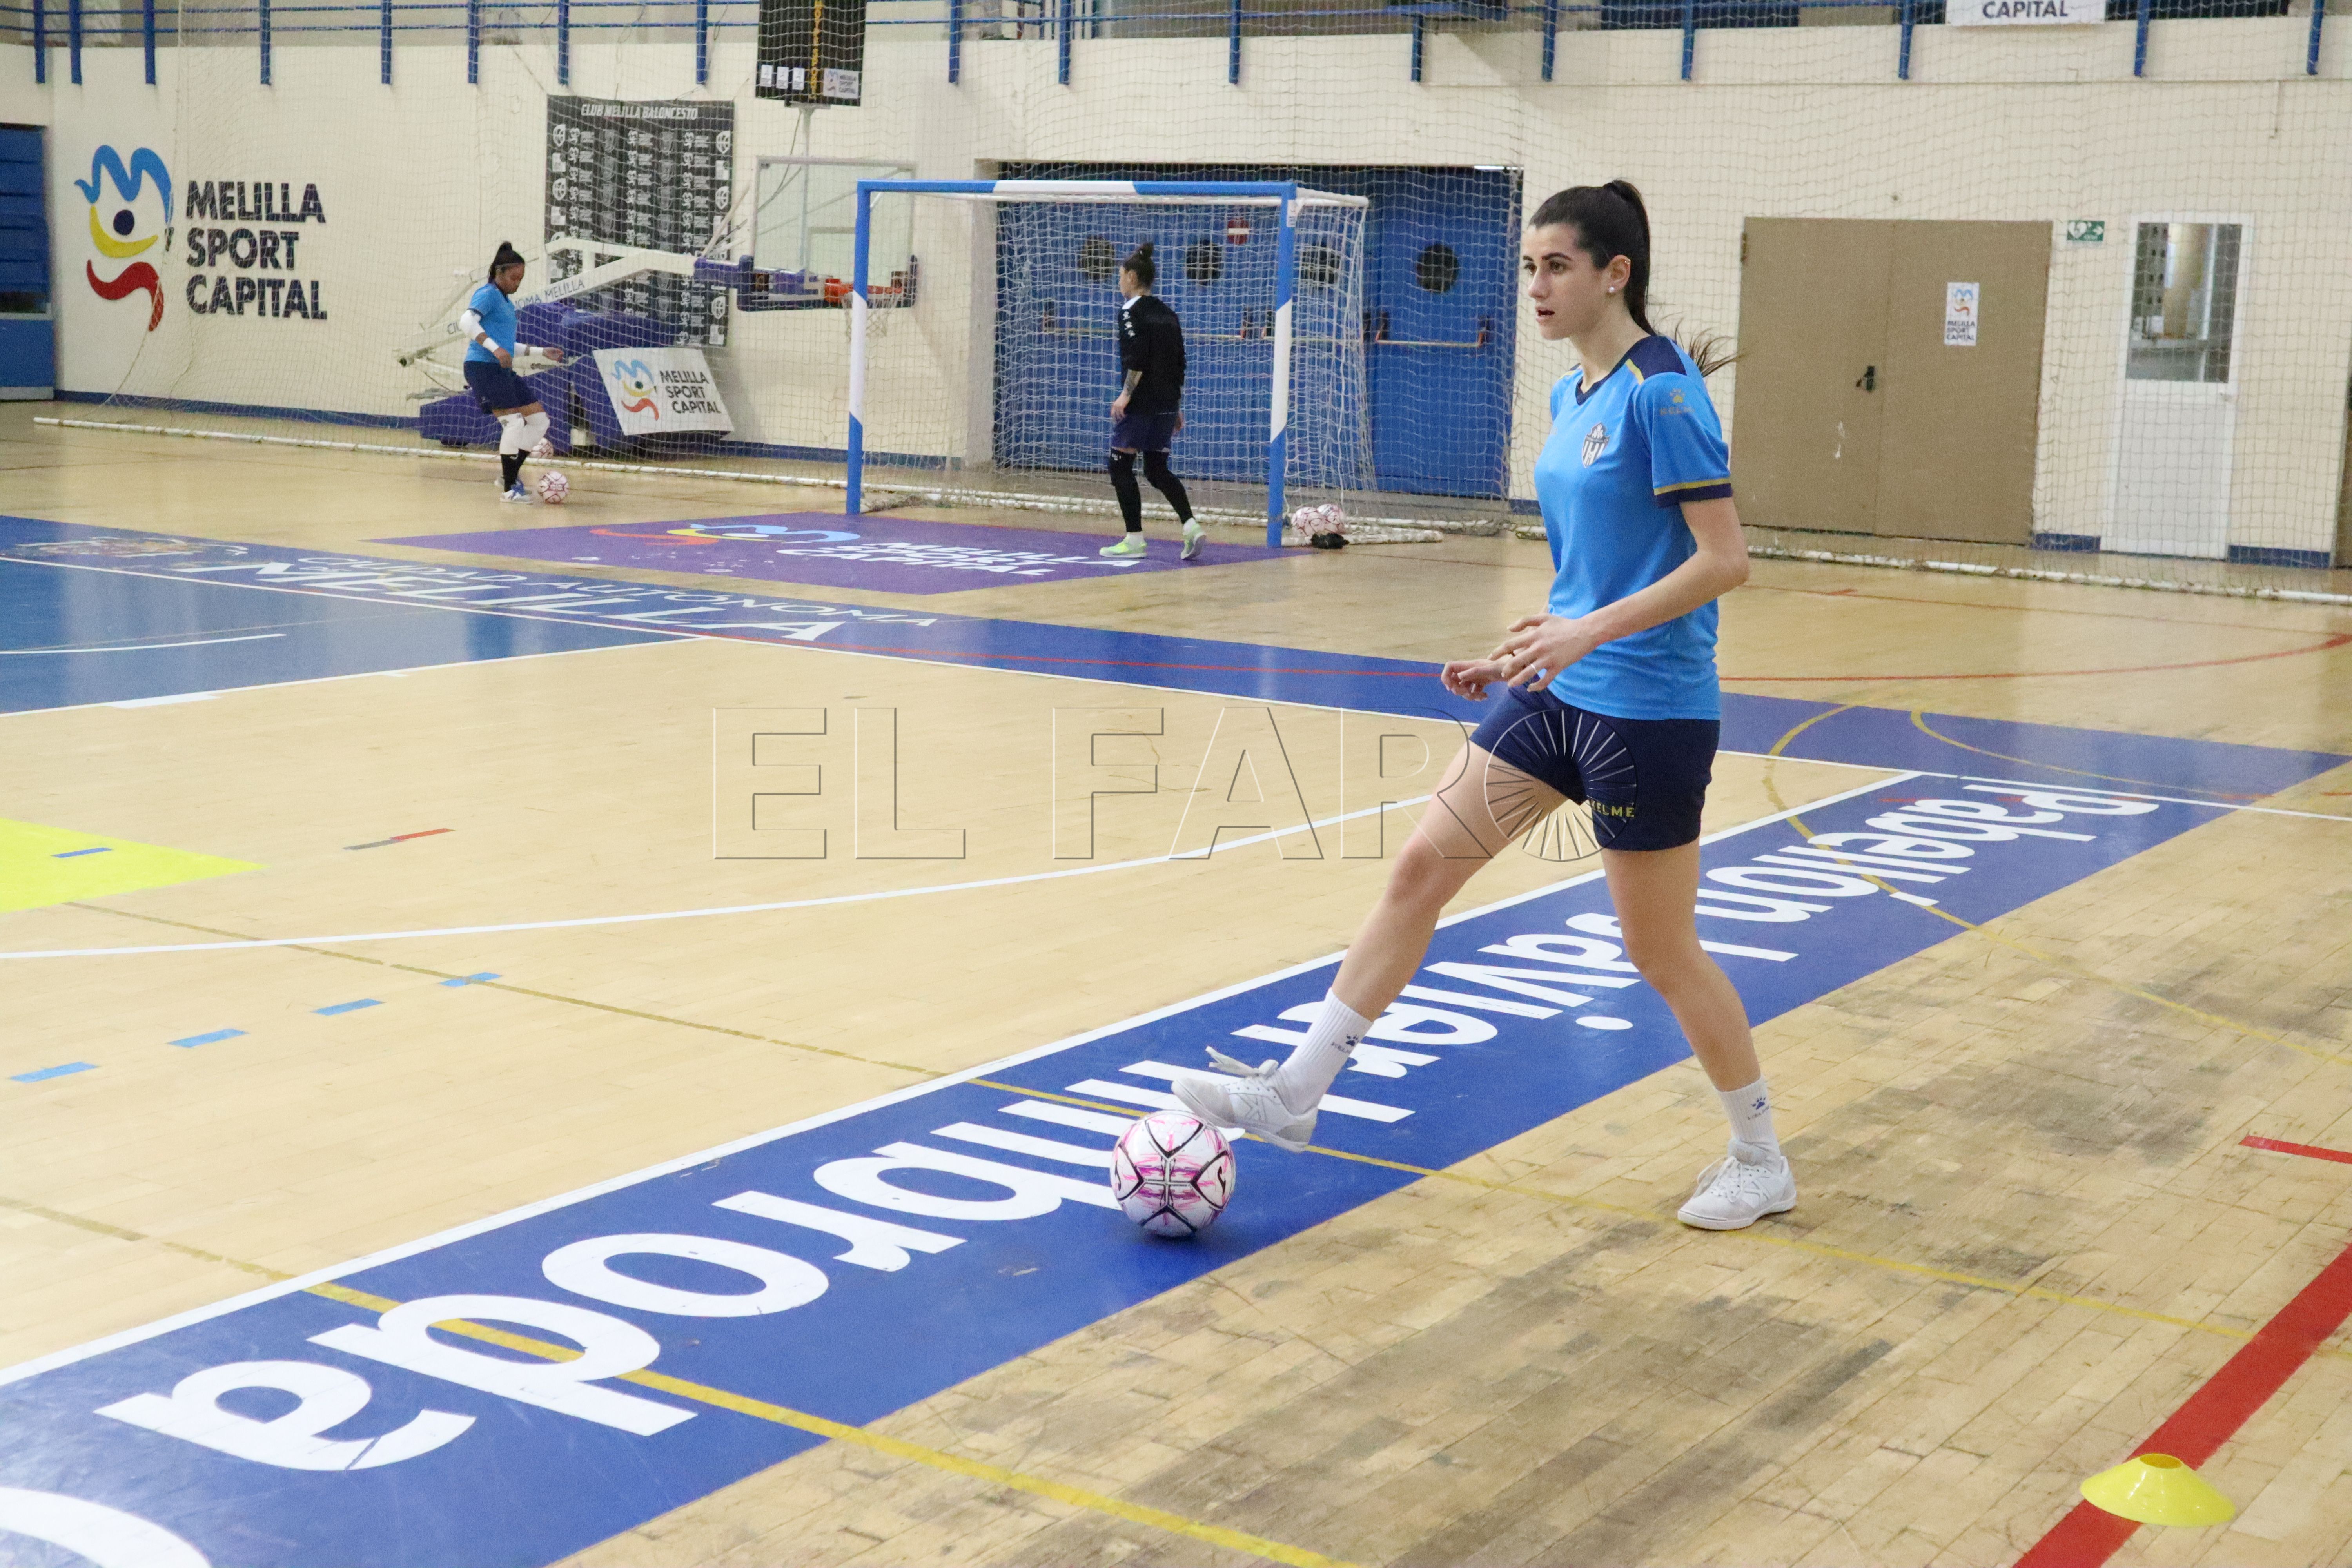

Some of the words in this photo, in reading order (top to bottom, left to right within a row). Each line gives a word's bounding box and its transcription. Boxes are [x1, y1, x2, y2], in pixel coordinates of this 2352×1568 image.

[1982, 0, 2069, 19] CAPITAL
[581, 104, 604, 116] CLUB
[604, 105, 641, 118] MELILLA
[186, 180, 326, 223] MELILLA
[186, 227, 299, 270] SPORT
[186, 274, 327, 320] CAPITAL
[544, 279, 585, 300] MELILLA
[659, 370, 710, 384] MELILLA
[665, 385, 706, 399] SPORT
[671, 401, 722, 414] CAPITAL
[775, 549, 1056, 575] CAPITAL
[817, 545, 1060, 565] SPORT
[861, 542, 1140, 567] MELILLA
[298, 557, 529, 582] CIUDAD
[167, 561, 846, 641] MELILLA
[1591, 799, 1635, 818] KELME
[1694, 783, 2161, 924] Pabellón
